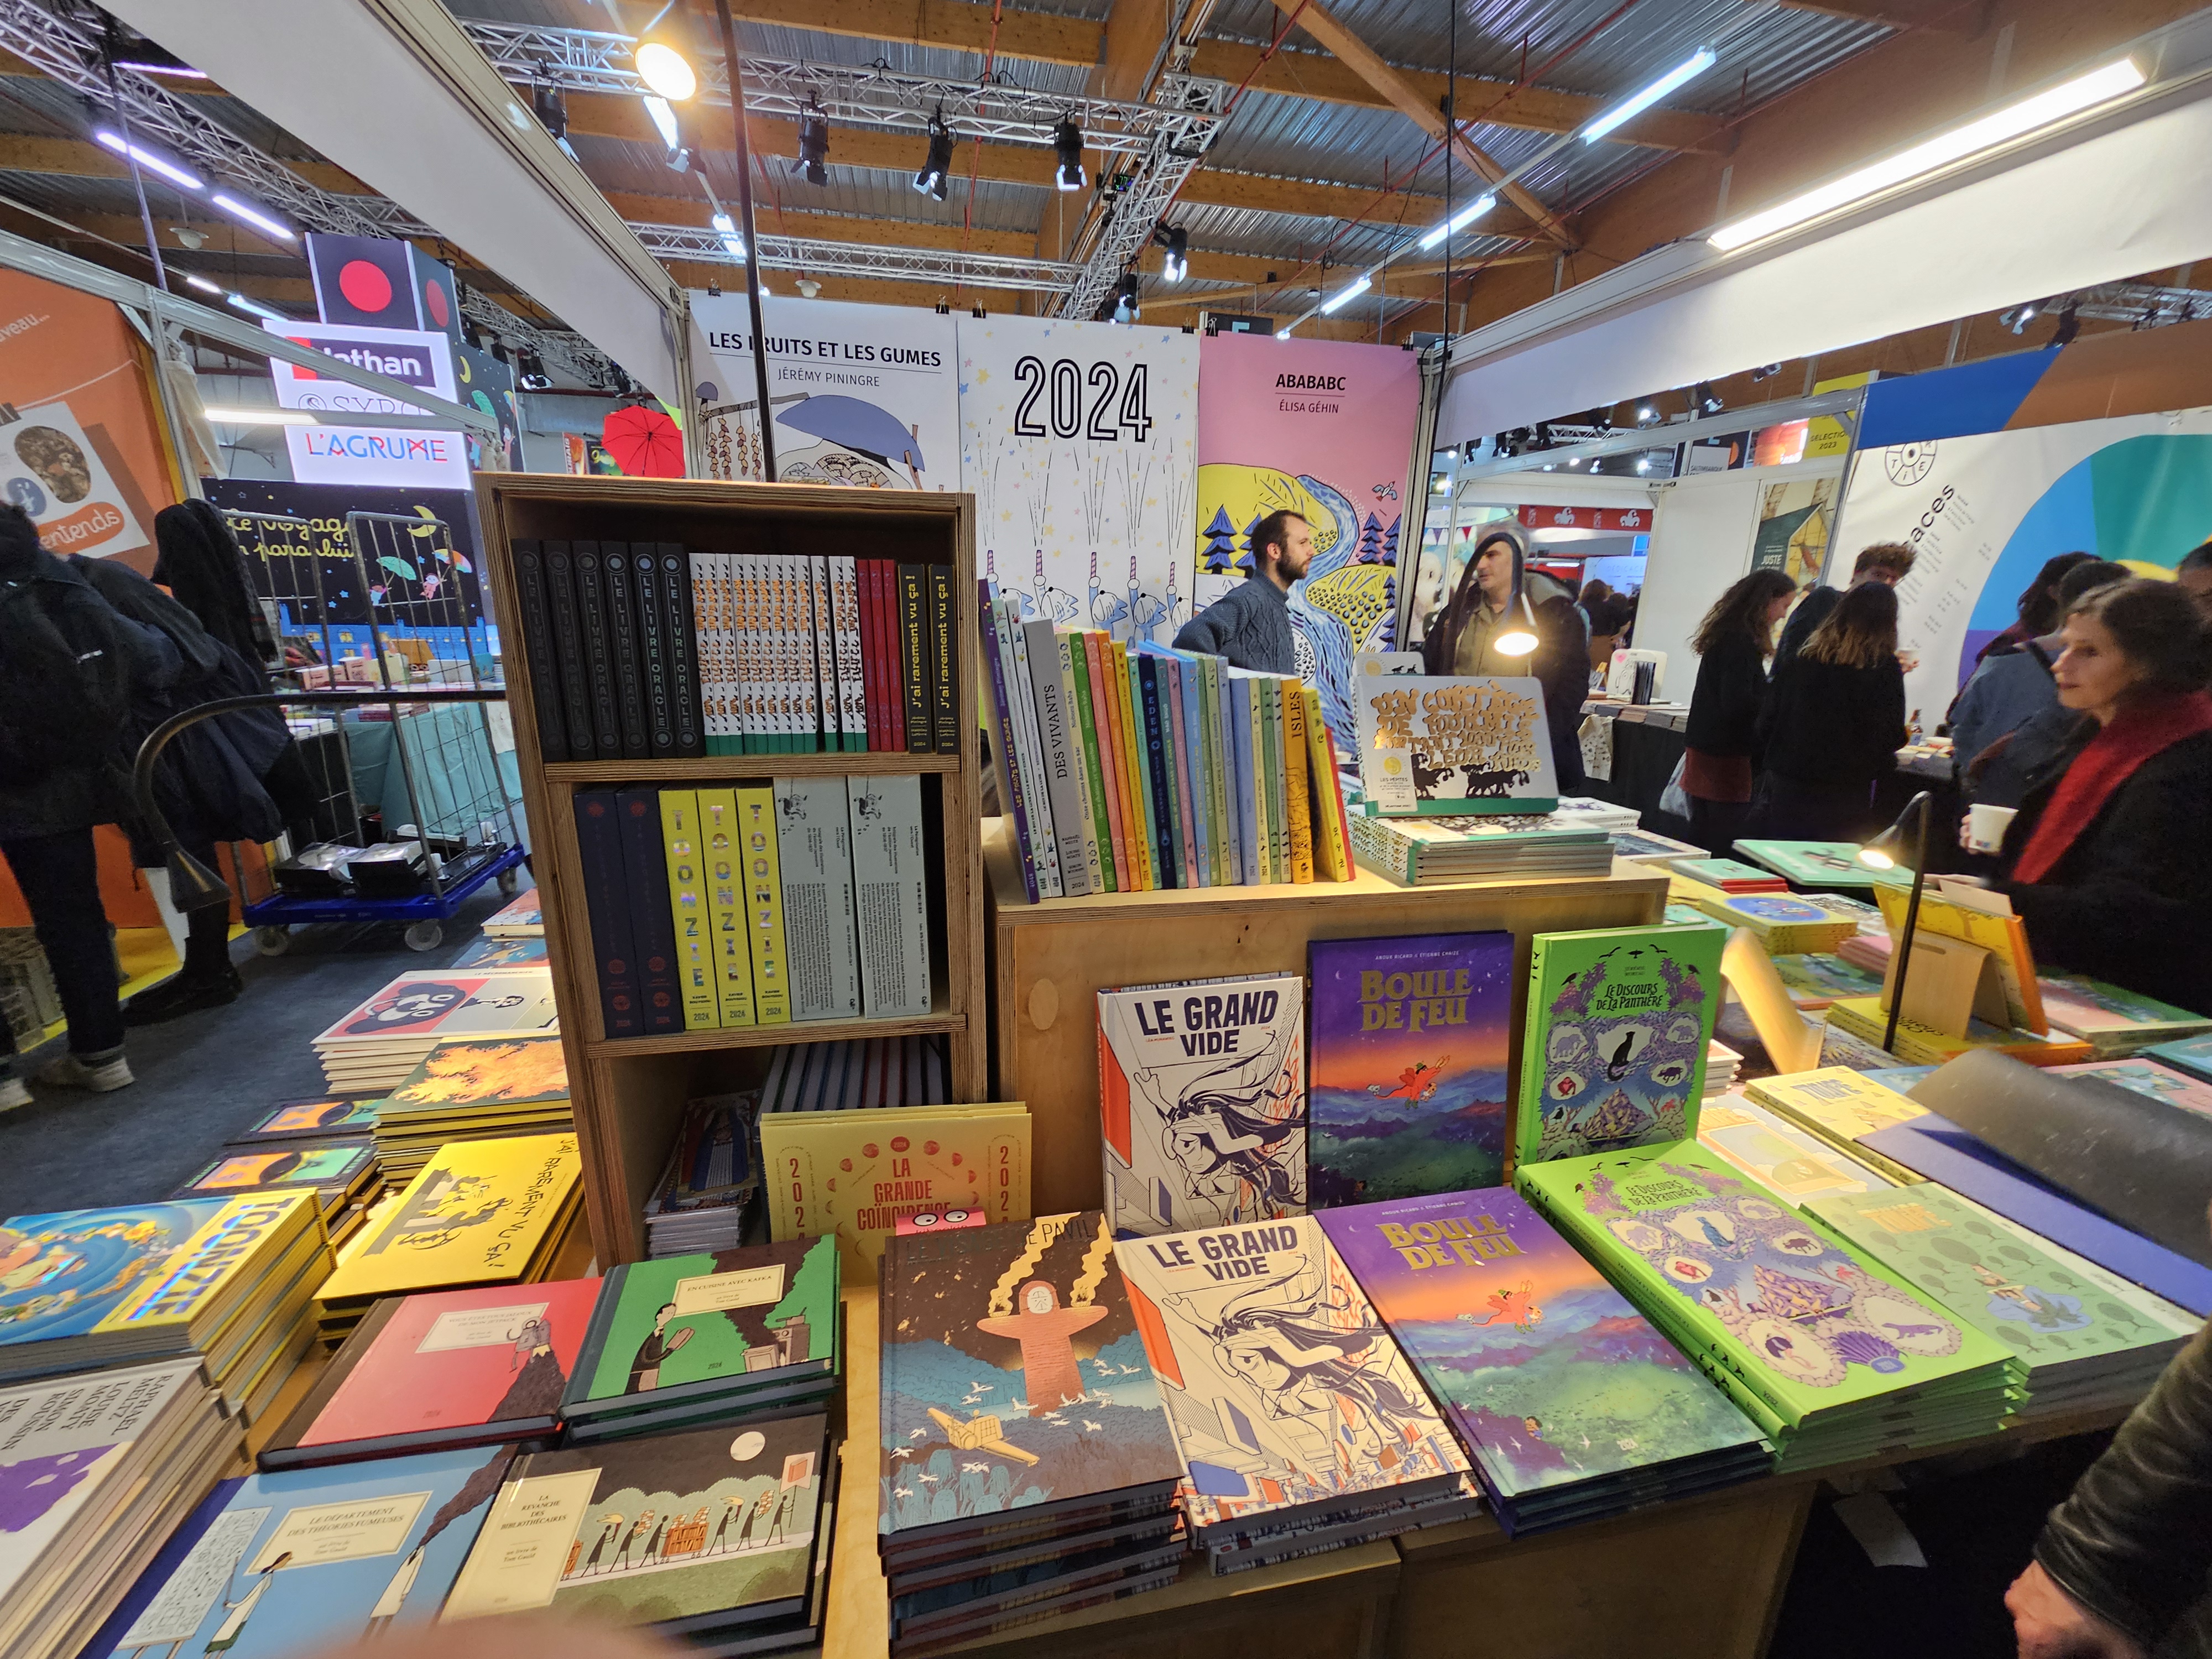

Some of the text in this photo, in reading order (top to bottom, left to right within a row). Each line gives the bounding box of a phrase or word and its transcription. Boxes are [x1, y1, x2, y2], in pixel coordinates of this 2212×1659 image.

[709, 331, 742, 349] LES
[818, 342, 838, 357] ET
[844, 343, 875, 361] LES
[880, 346, 941, 367] GUMES
[777, 366, 880, 387] JÉRÉMY PININGRE
[1276, 373, 1347, 391] ABABABC
[1014, 356, 1152, 442] 2024
[1279, 398, 1339, 414] ÉLISA GÉHIN
[305, 433, 448, 462] L'AGRUME
[614, 575, 623, 597] LE
[908, 583, 919, 598] ça
[938, 583, 950, 598] ça
[910, 603, 917, 620] vu
[940, 603, 947, 620] vu
[643, 577, 665, 727] LE LIVRE ORACLE
[670, 578, 691, 727] LE LIVRE ORACLE
[910, 622, 920, 684] rarement
[939, 622, 949, 684] rarement
[911, 687, 921, 708] J'ai
[940, 687, 950, 708] J'ai
[1148, 696, 1160, 742] EDEN
[1291, 690, 1302, 738] ISLES
[1377, 714, 1413, 736] DE
[1044, 684, 1067, 779] DES VIVANTS
[673, 810, 704, 986] TOONZIE
[710, 805, 738, 981] TOONZIE
[750, 804, 775, 978] TOONZIE
[1357, 968, 1474, 1003] BOULE
[1616, 983, 1658, 997] DISCOURS
[693, 1013, 709, 1021] 2024
[729, 1010, 745, 1018] 2024
[766, 1007, 781, 1015] 2024
[1134, 990, 1279, 1036] LE GRAND
[1359, 997, 1469, 1032] DE FEU
[1180, 1029, 1240, 1057] VIDE
[556, 1139, 575, 1154] J'AI
[893, 1158, 911, 1178] LA
[515, 1157, 562, 1217] RAREMENT
[874, 1180, 933, 1203] GRANDE
[1635, 1180, 1683, 1193] DISCOURS
[498, 1220, 529, 1238] VU
[1041, 1219, 1094, 1243] PAVIL
[1375, 1213, 1507, 1248] BOULE
[484, 1243, 511, 1262] ÇA
[1146, 1225, 1298, 1268] LE GRAND
[1396, 1233, 1528, 1270] DE FEU
[1202, 1256, 1270, 1281] VIDE
[698, 1282, 726, 1290] CUISINE
[35, 1388, 85, 1431] SIMON
[59, 1384, 111, 1431] MOATY
[85, 1381, 131, 1428] LOUISE
[0, 1392, 66, 1451] ROUSSIN
[324, 1507, 395, 1521] DÉPARTEMENT
[521, 1500, 561, 1511] REVANCHE
[286, 1528, 305, 1537] DES
[355, 1515, 405, 1527] FUMEUSES
[500, 1514, 567, 1530] BIBLIOTHÉCAIRES
